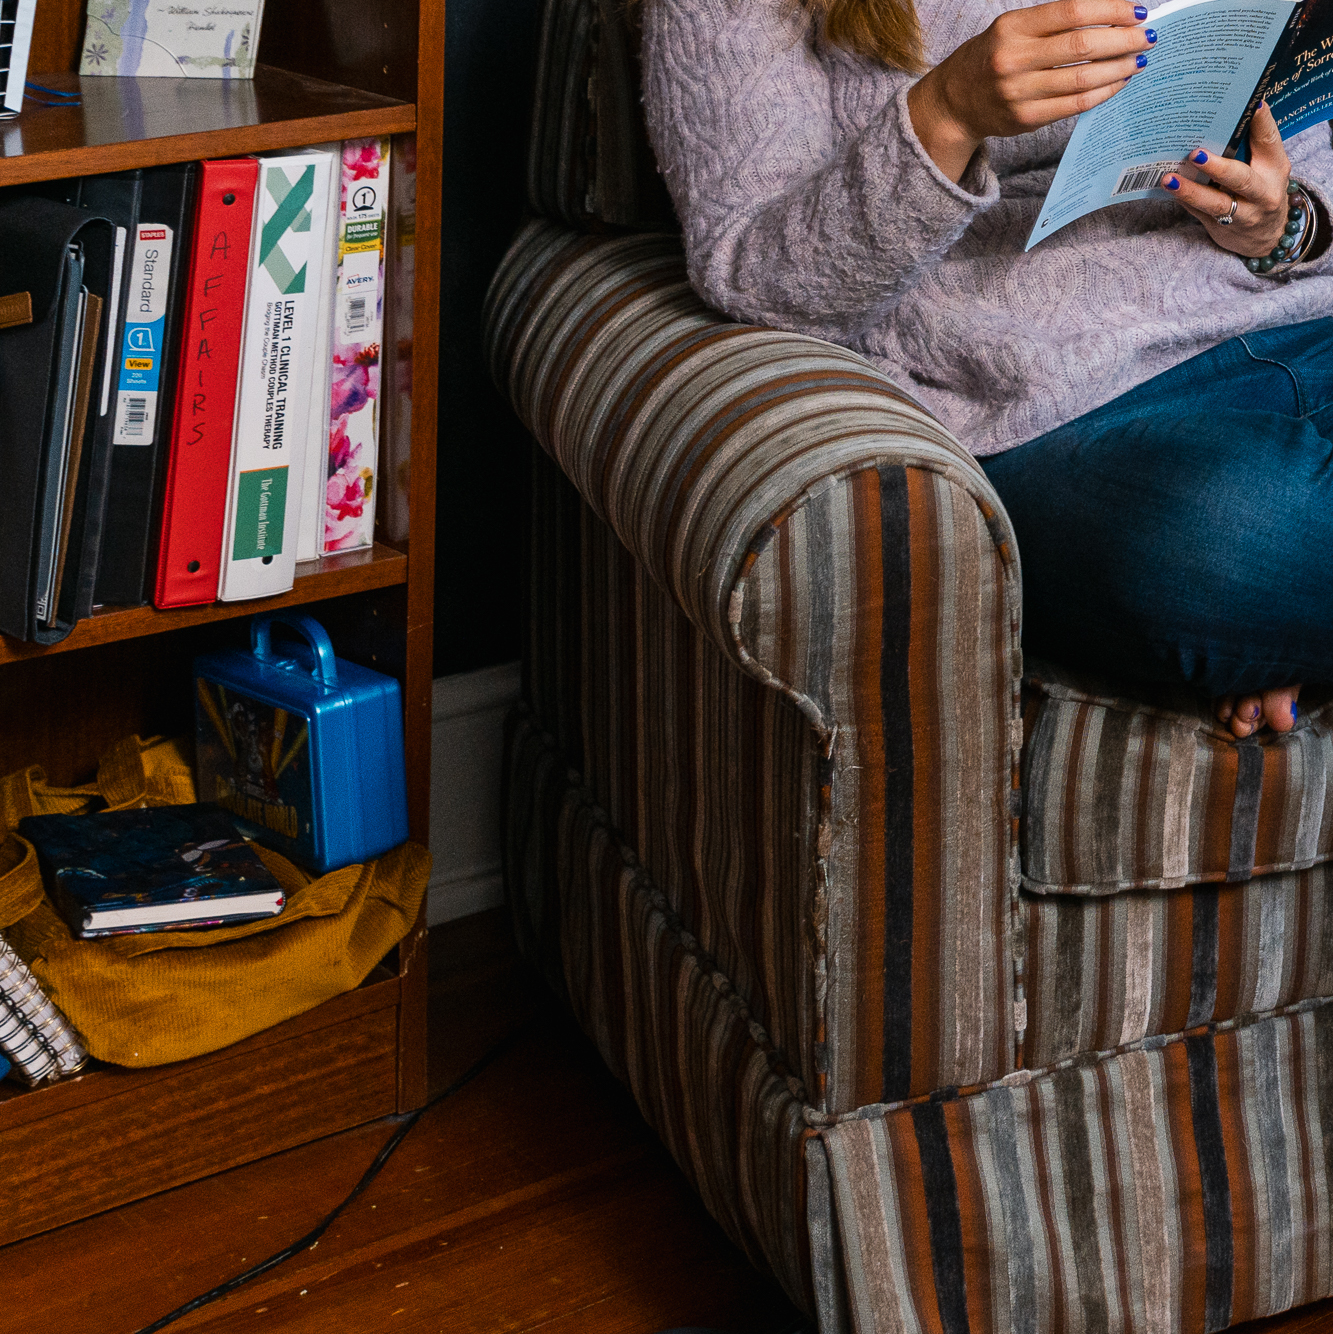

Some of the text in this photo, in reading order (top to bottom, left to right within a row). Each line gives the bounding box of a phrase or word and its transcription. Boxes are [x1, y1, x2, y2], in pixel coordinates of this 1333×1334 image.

[1294, 48, 1318, 66] The
[1263, 77, 1290, 101] Edge
[1291, 65, 1305, 82] of
[347, 222, 378, 233] DURABLE
[345, 243, 378, 253] Clear Cover
[139, 249, 159, 313] Standard
[346, 275, 374, 286] AVERY
[186, 231, 231, 446] AFFAIRS
[129, 359, 151, 368] View
[262, 301, 283, 450] GOTTMAN METHOD COUPLES THERAPY
[272, 300, 295, 450] LEVEL CLINICAL TRAINING
[256, 478, 273, 550] The Gottman Institute
